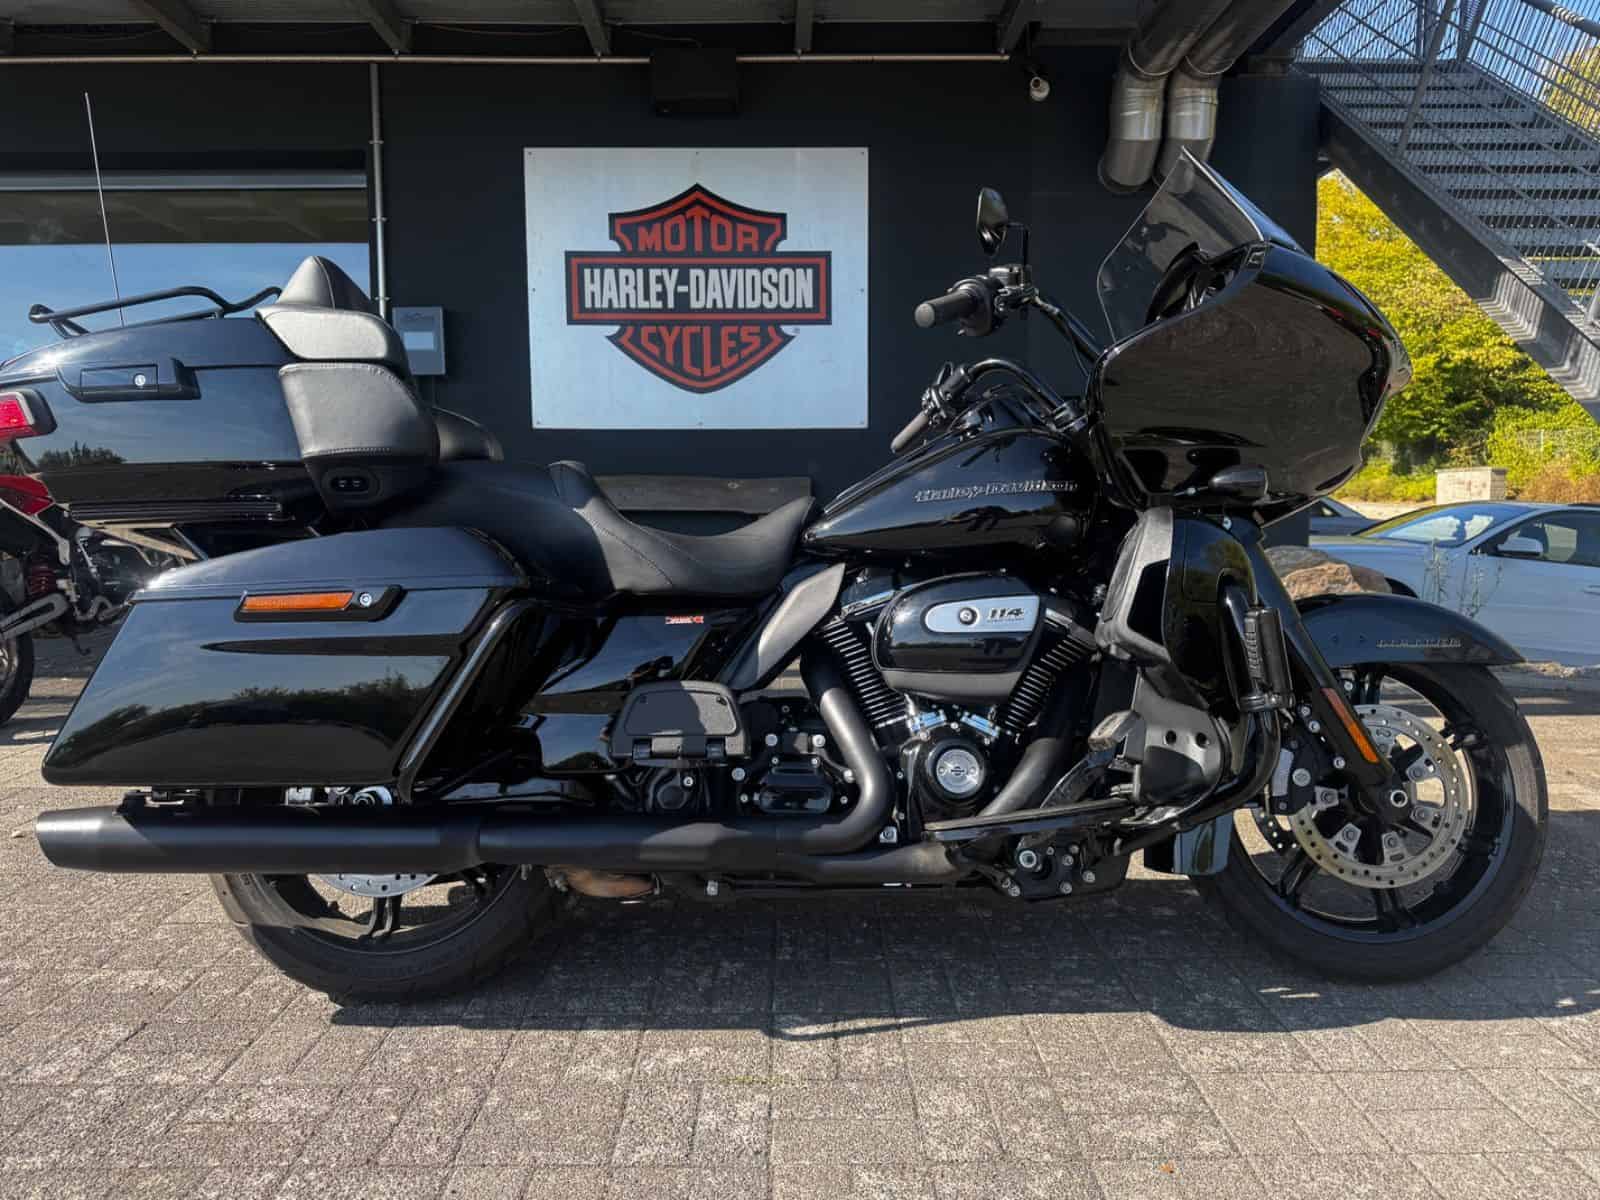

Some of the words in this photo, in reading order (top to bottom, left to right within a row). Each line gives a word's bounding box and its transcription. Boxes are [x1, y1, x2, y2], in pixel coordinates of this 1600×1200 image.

[637, 204, 759, 251] MOTOR
[583, 267, 814, 309] HARLEY-DAVIDSON
[641, 325, 761, 377] CYCLES
